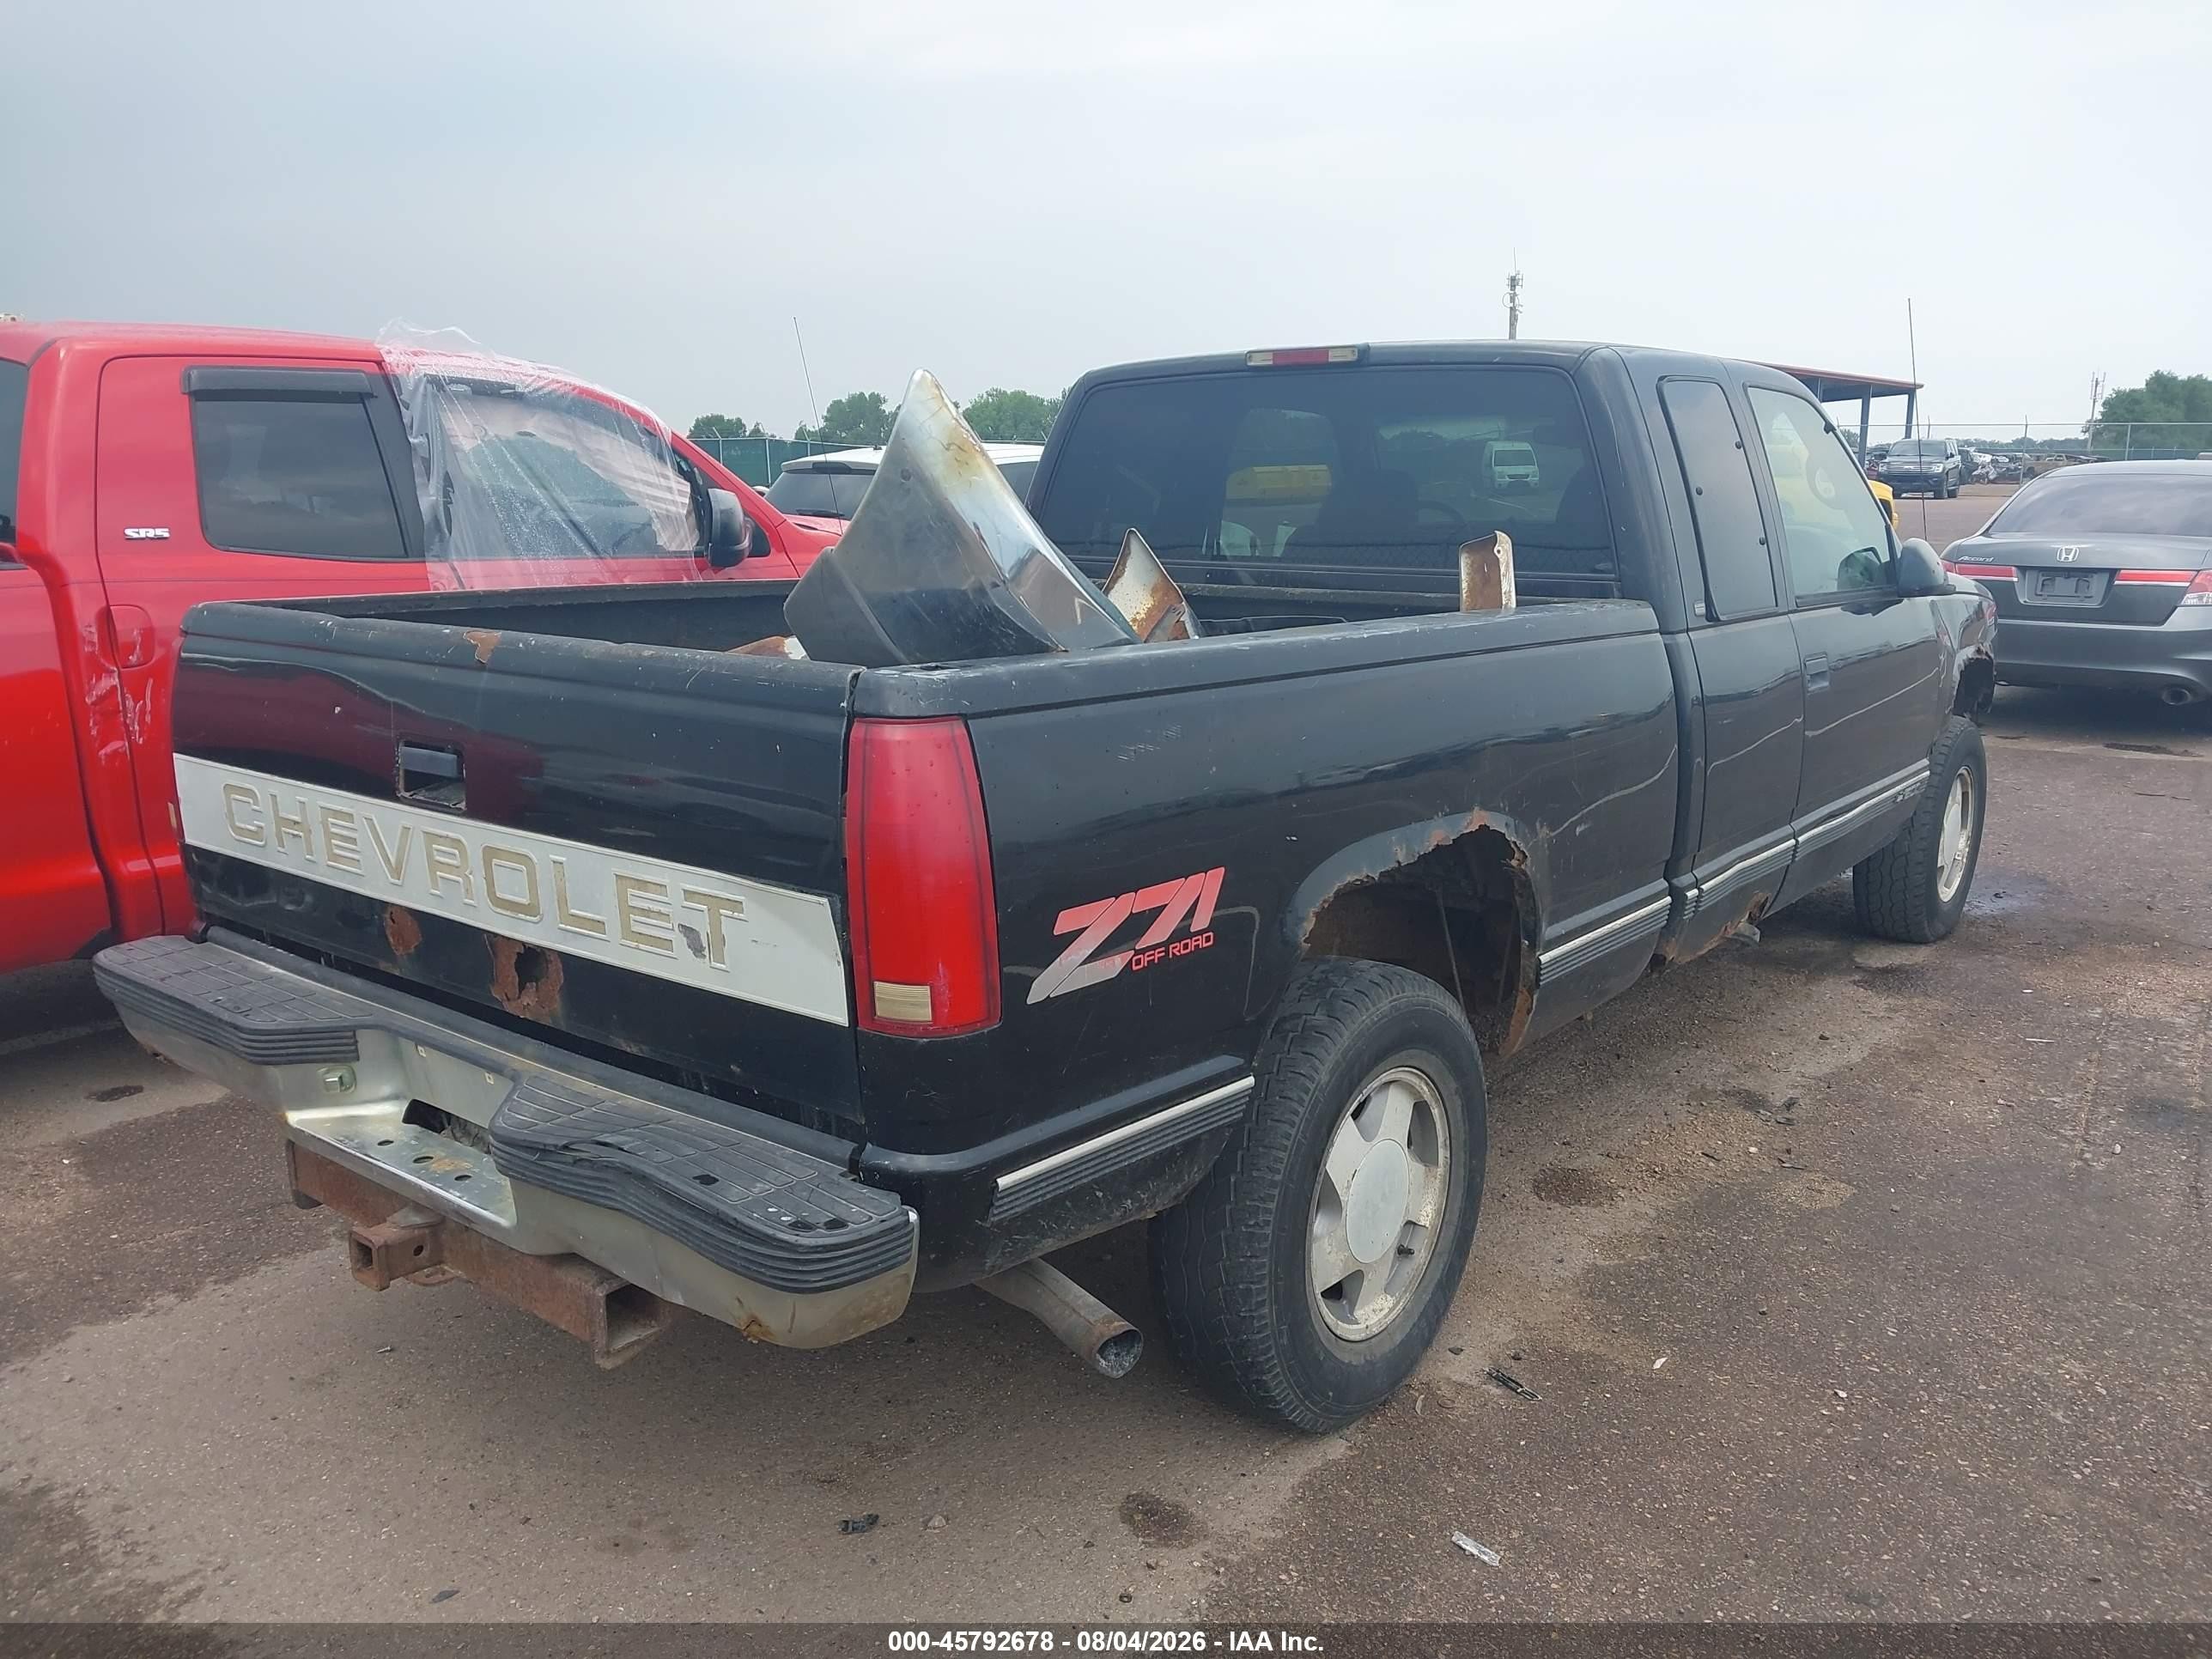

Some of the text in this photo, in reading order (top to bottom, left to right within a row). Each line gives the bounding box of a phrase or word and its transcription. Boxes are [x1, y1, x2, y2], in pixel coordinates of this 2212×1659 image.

[124, 527, 171, 538] SR5
[222, 781, 747, 972] CHEVROLET
[1026, 866, 1225, 1005] Z71
[1132, 932, 1214, 971] OFF ROAD
